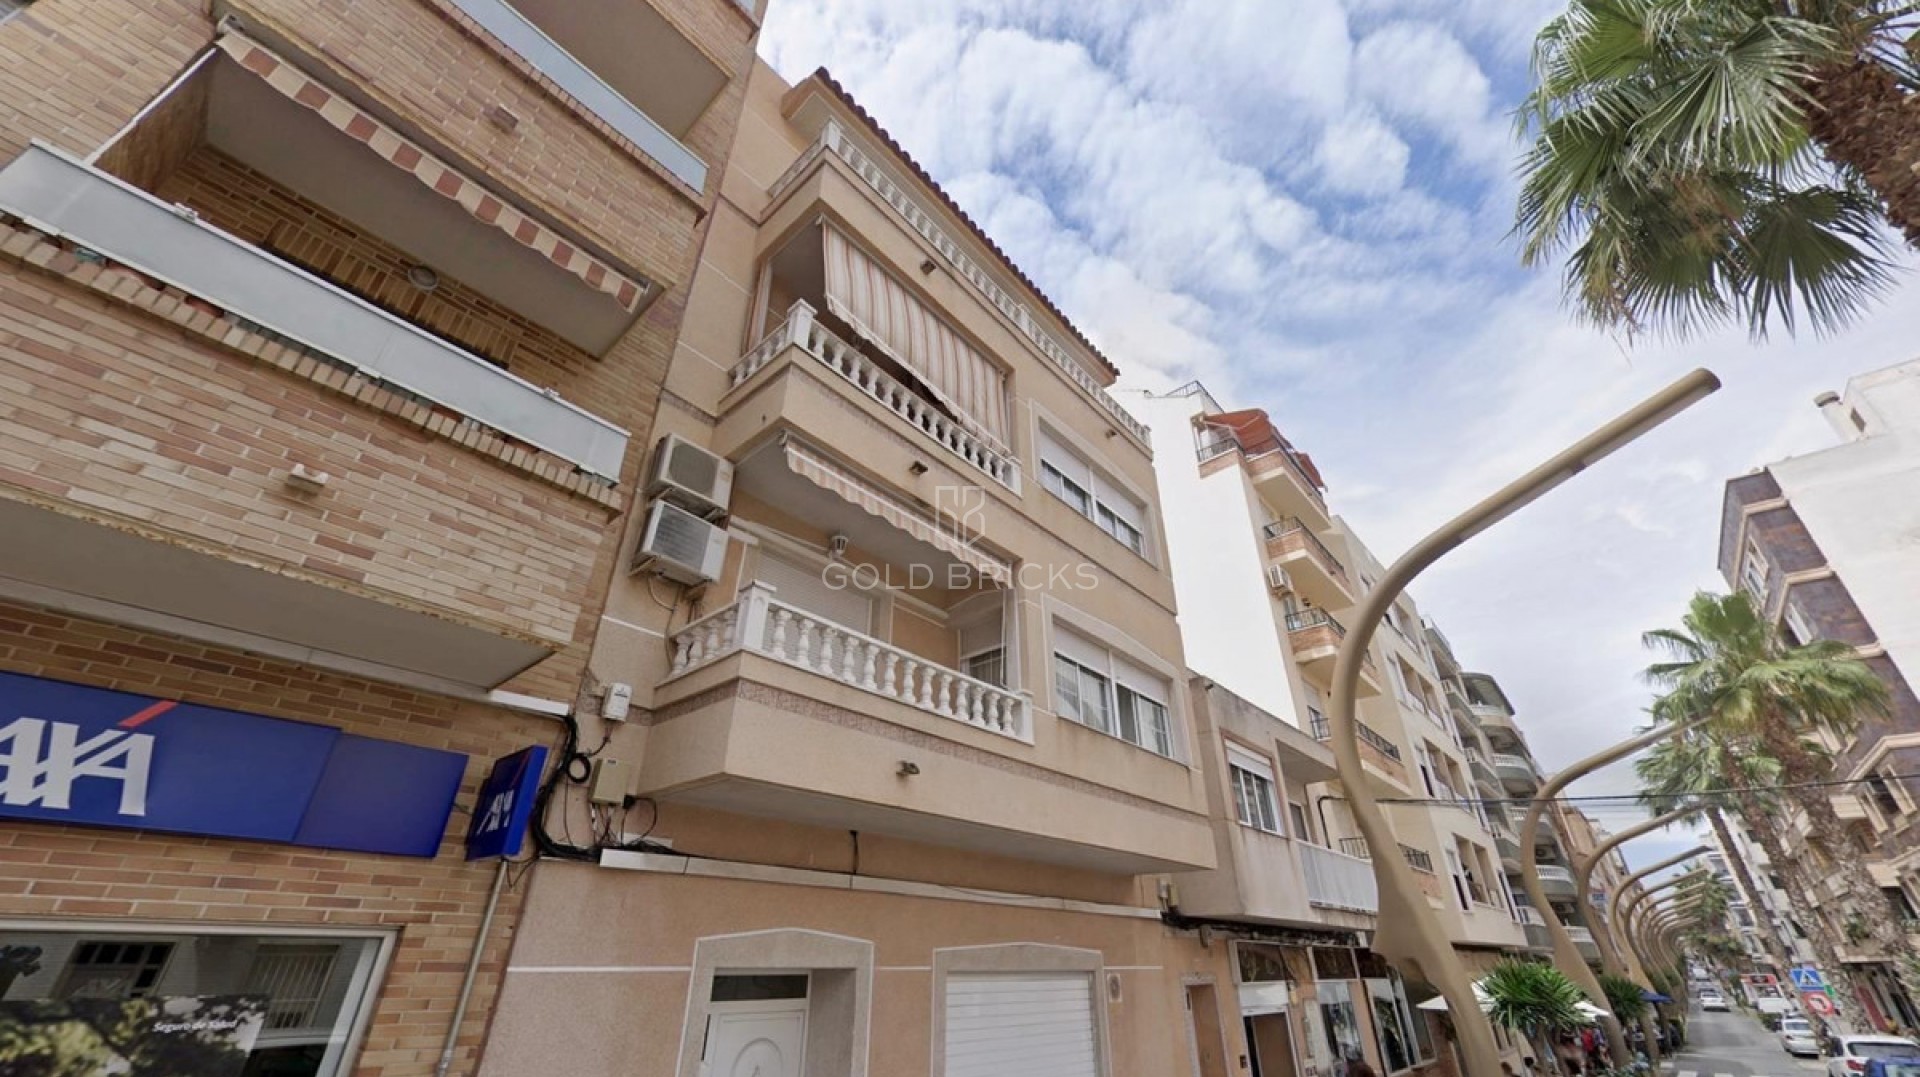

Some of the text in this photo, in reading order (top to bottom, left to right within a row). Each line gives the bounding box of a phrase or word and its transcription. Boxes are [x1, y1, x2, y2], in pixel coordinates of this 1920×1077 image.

[0, 717, 156, 817] AXA
[152, 1021, 192, 1033] Seguro
[192, 1020, 206, 1031] de
